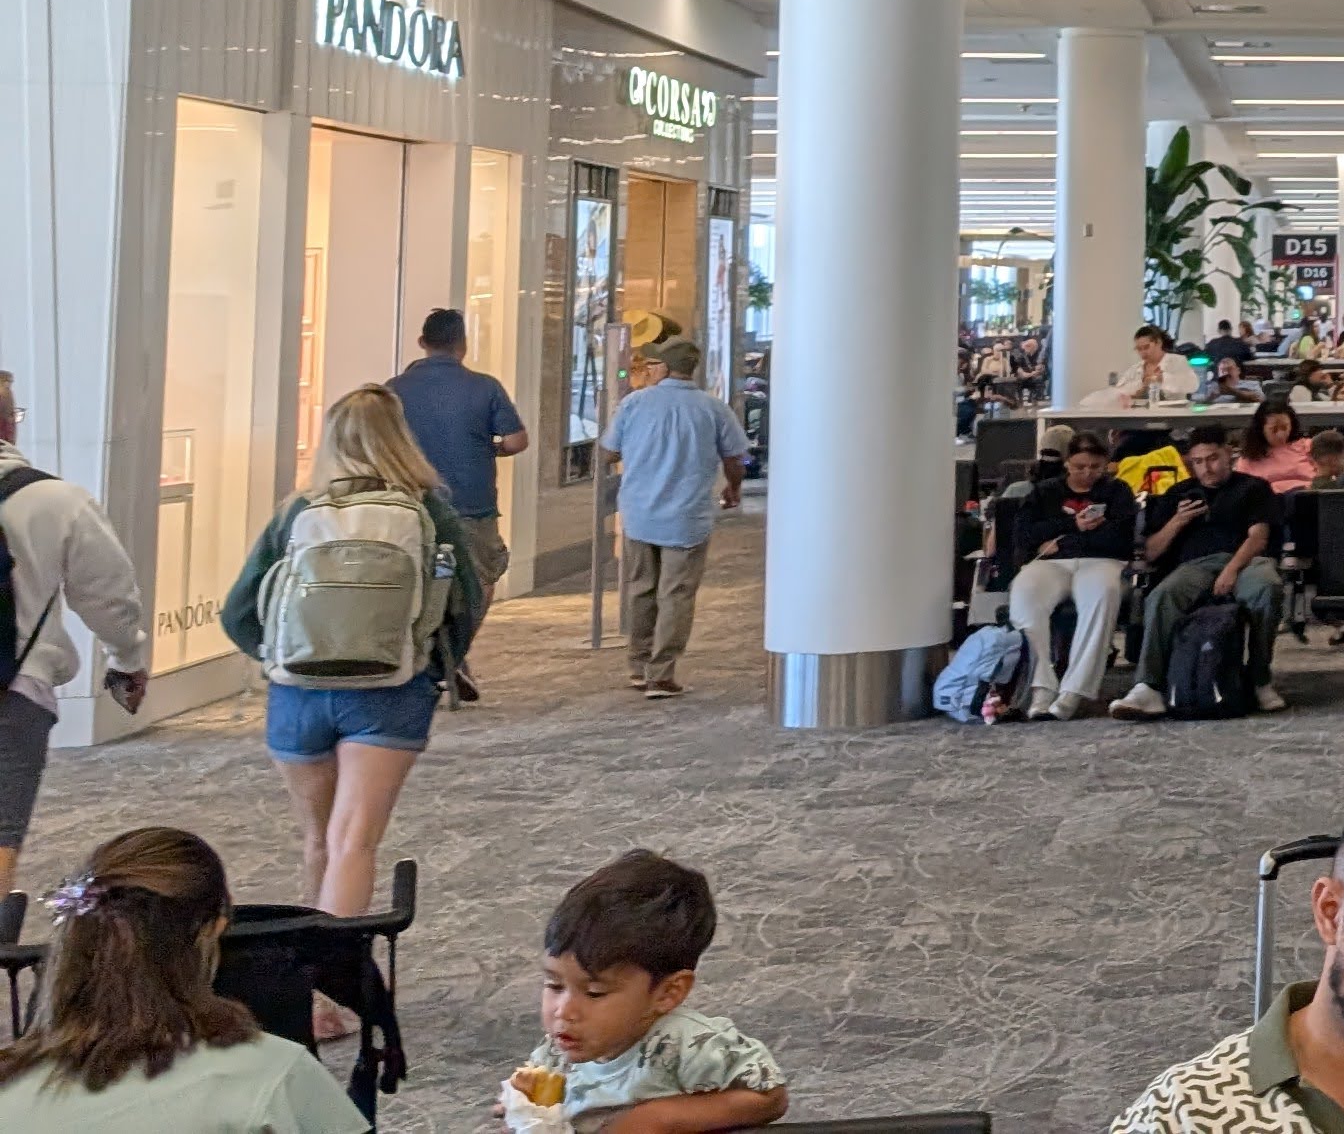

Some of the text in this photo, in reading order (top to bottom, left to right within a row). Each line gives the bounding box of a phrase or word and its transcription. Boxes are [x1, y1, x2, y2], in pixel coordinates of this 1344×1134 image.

[645, 70, 703, 128] CORSA
[1285, 237, 1328, 256] D15
[1303, 267, 1328, 278] D16
